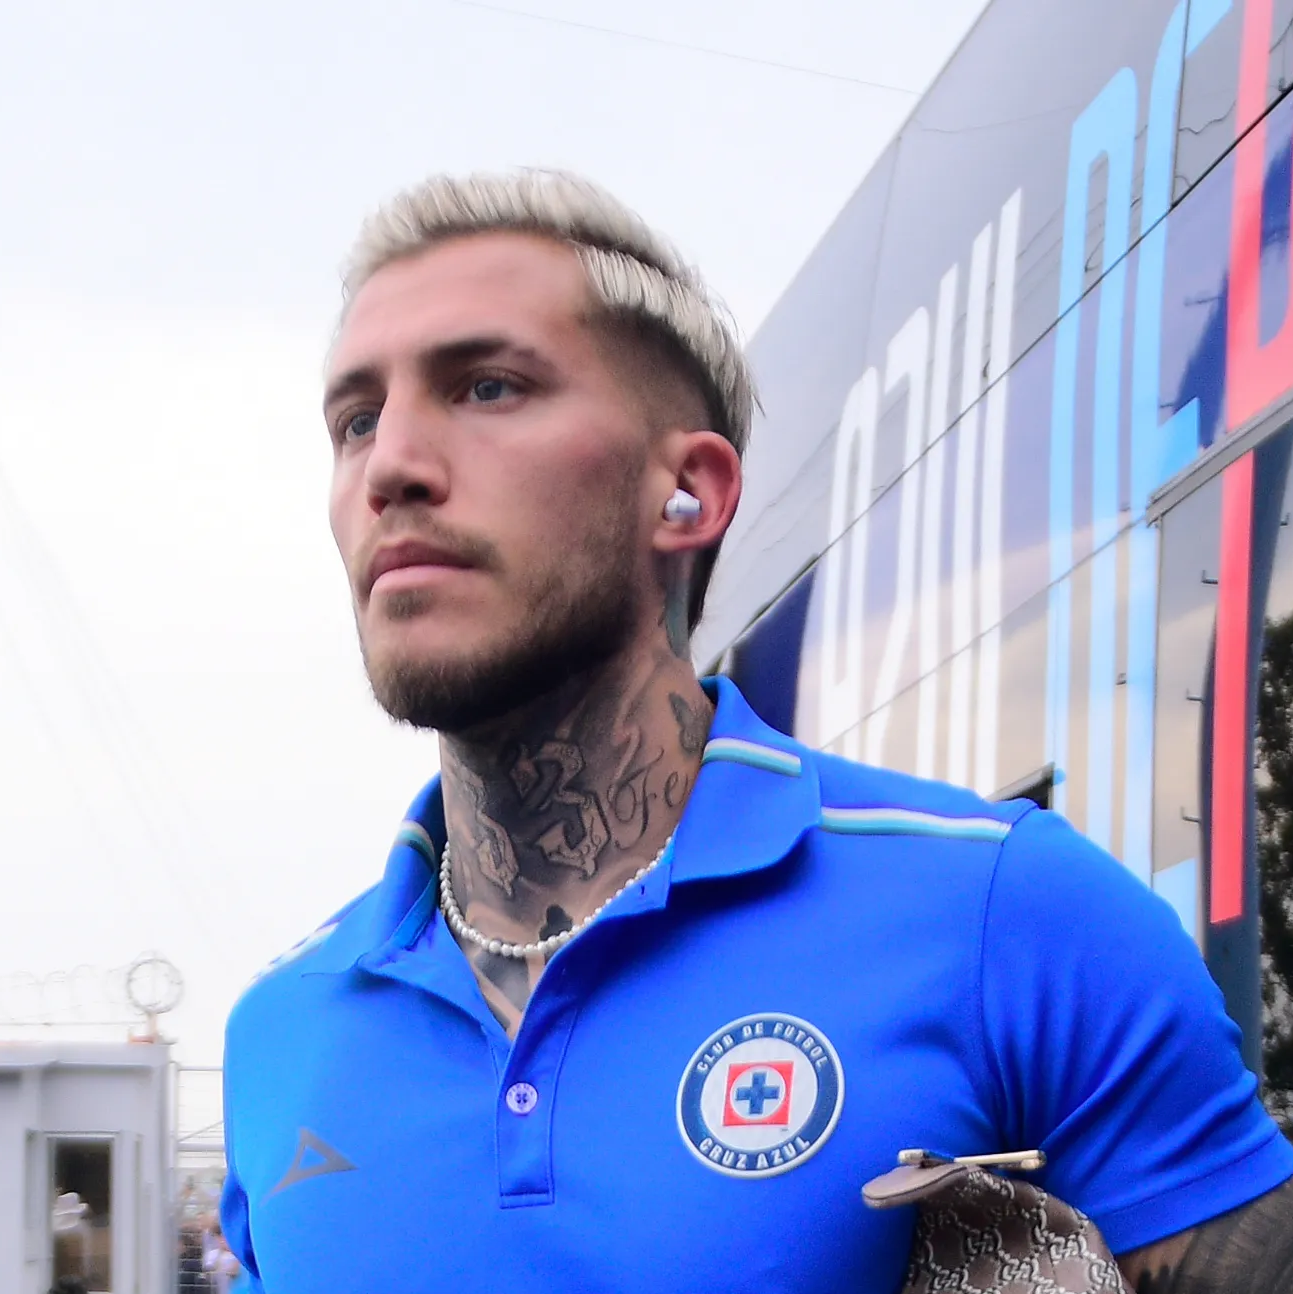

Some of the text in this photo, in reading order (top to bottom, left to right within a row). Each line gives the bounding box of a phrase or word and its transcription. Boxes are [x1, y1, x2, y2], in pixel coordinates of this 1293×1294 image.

[697, 1022, 829, 1071] CLUB DE FUTBOL
[699, 1136, 810, 1169] CRUZ AZUL
